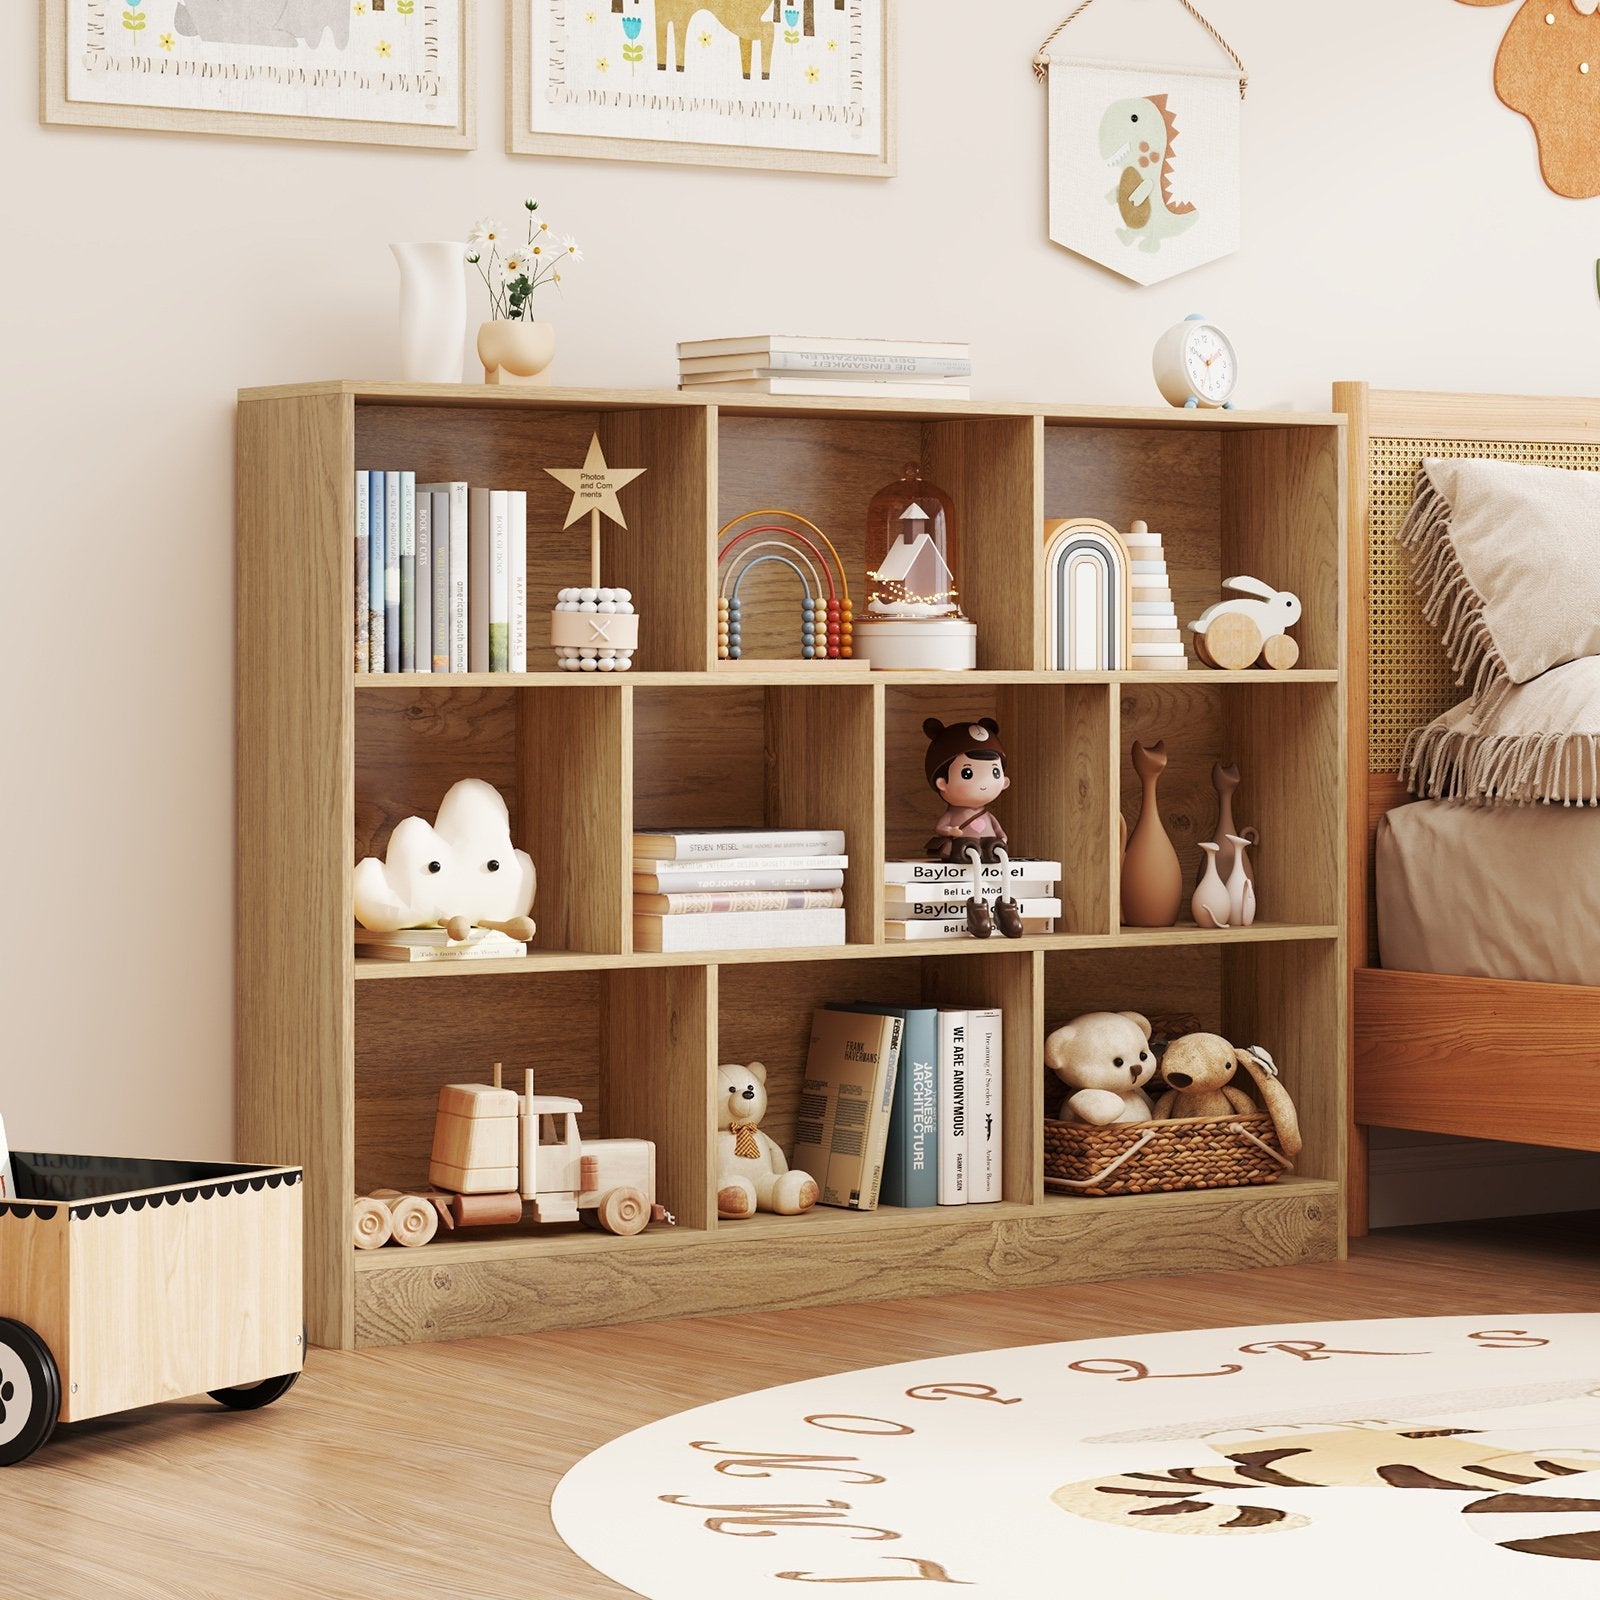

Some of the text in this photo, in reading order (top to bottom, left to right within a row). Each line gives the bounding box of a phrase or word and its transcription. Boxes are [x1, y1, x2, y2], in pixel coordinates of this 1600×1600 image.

[810, 360, 916, 372] DIE EINSAMKEIT
[580, 473, 605, 481] Photos
[580, 481, 613, 490] and Com
[419, 509, 427, 566] BOOK OF CATS
[456, 581, 465, 618] american
[456, 619, 466, 642] south
[689, 843, 714, 852] STEVEN
[716, 843, 739, 851] MEISEL
[914, 866, 1024, 880] Baylor Moel
[944, 888, 958, 896] Bel
[981, 887, 1002, 895] Mod
[914, 902, 967, 917] Baylor
[944, 925, 958, 933] Bel
[846, 1041, 865, 1052] FRANK
[983, 1032, 992, 1106] Dreaming of Sweden
[953, 1026, 964, 1137] WE ARE ANONYMOUS
[923, 1062, 934, 1133] JAPANESE
[913, 1062, 925, 1170] ARCHITECTURE
[803, 1414, 914, 1435] O
[905, 1383, 1023, 1405] P
[1467, 1330, 1549, 1348] S
